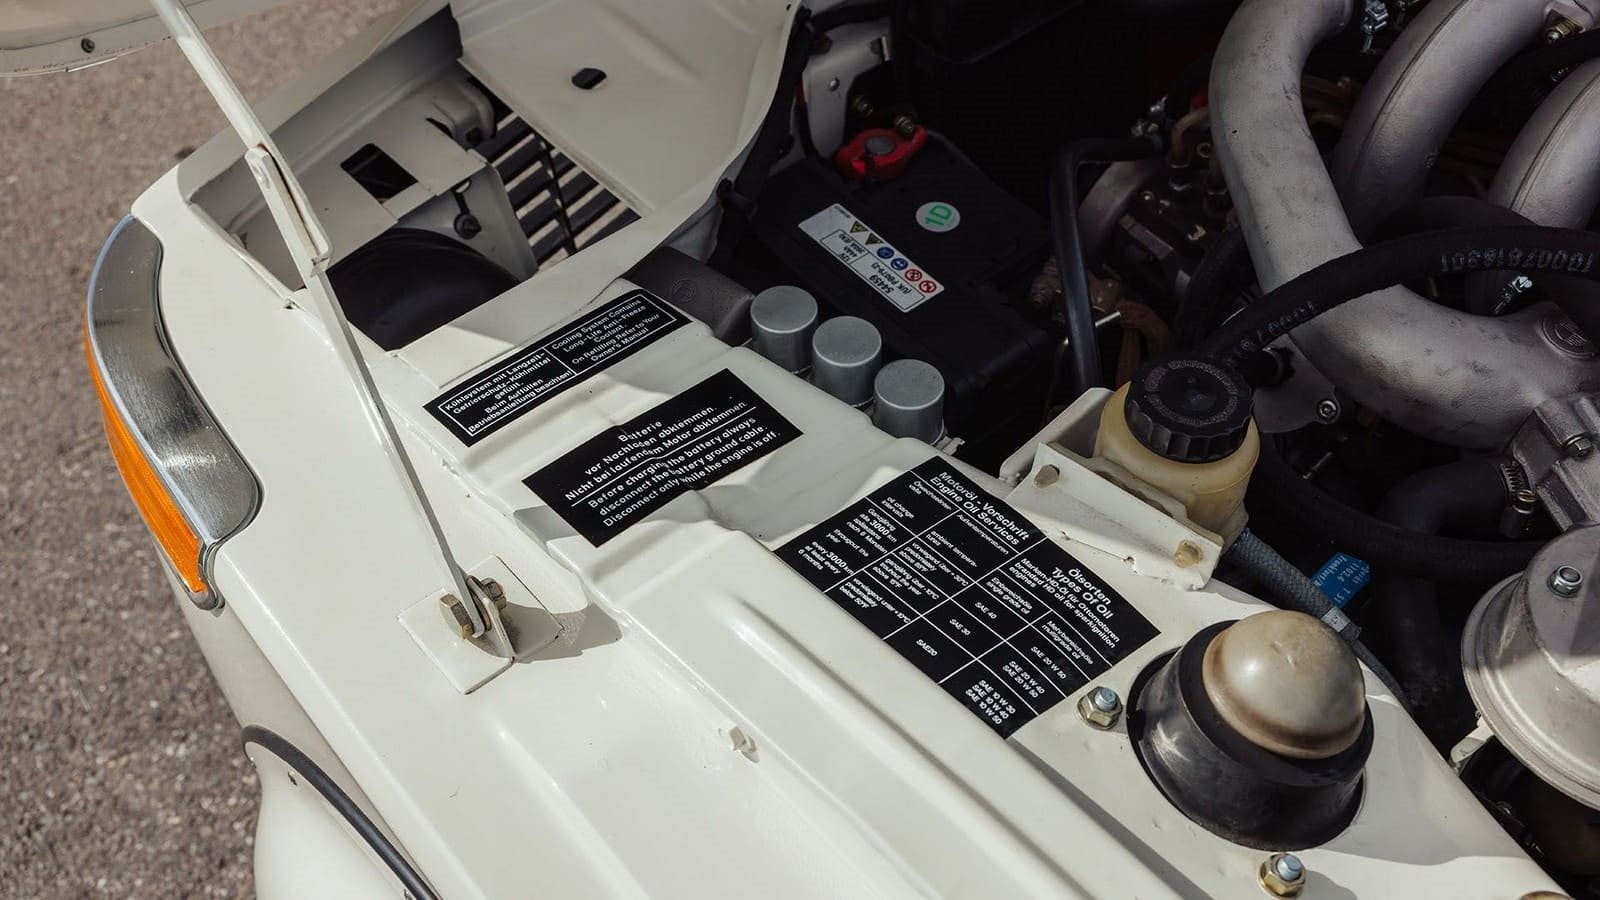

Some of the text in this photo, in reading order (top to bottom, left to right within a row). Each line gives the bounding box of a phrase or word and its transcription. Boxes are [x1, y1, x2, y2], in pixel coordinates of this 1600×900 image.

[552, 300, 641, 350] Cooling System Contains
[563, 306, 646, 352] Long-Life Anti-Freeze
[572, 356, 585, 364] On
[583, 339, 617, 358] Refilling
[615, 327, 636, 340] Refer
[642, 314, 660, 324] Your
[594, 325, 627, 342] Coolant.
[591, 327, 649, 361] Owner's Manual
[445, 353, 545, 410] Kühlsystem mit Langzeit-
[453, 357, 551, 414] Gefrierschutz-Kühlmittel
[484, 379, 544, 413] Beim Auffüllen
[495, 382, 524, 400] gefüllt.
[468, 370, 572, 432] Betriebsanleitung beachten!
[585, 407, 716, 475] vor Nachladen abklemmen.
[618, 422, 662, 442] Batterie
[565, 481, 594, 500] Nicht
[593, 470, 612, 483] bei
[610, 447, 664, 473] laufendem
[662, 431, 691, 448] Motor
[588, 418, 756, 508] Before charging the battery always
[600, 427, 767, 515] disconnect the battery ground cable.
[603, 431, 780, 526] Disconnect only while the engine is off.
[894, 502, 914, 518] change
[930, 477, 1019, 545] Engine Oil Services
[939, 472, 978, 501] Motoröl
[983, 503, 1029, 540] Vorschrift
[869, 520, 890, 535] 3000
[887, 534, 897, 543] km
[811, 550, 826, 562] least
[824, 561, 841, 574] every
[812, 541, 854, 575] every 3000 km
[858, 548, 869, 557] the
[986, 581, 1004, 595] single
[1002, 594, 1021, 608] grade
[1009, 567, 1036, 588] engines
[1052, 567, 1114, 619] Types Of Oil
[1068, 568, 1111, 605] Ölsorten
[975, 602, 989, 613] SAE
[1014, 562, 1117, 648] branded HD oil for sparkignition
[1067, 594, 1079, 603] für
[1078, 603, 1120, 642] Ottomotoren
[949, 619, 971, 636] SAE 30
[1009, 661, 1045, 694] SAE 20 W 40
[1031, 646, 1045, 658] SAE
[1043, 657, 1052, 665] 20
[1057, 670, 1066, 679] 50
[979, 680, 1016, 714] SAE 10 W 30
[1002, 665, 1038, 698] SAE 20 W 50
[965, 689, 1002, 724] SAE 10 W 50
[972, 684, 987, 698] SAE
[992, 702, 1001, 711] W
[999, 711, 1009, 719] 40
